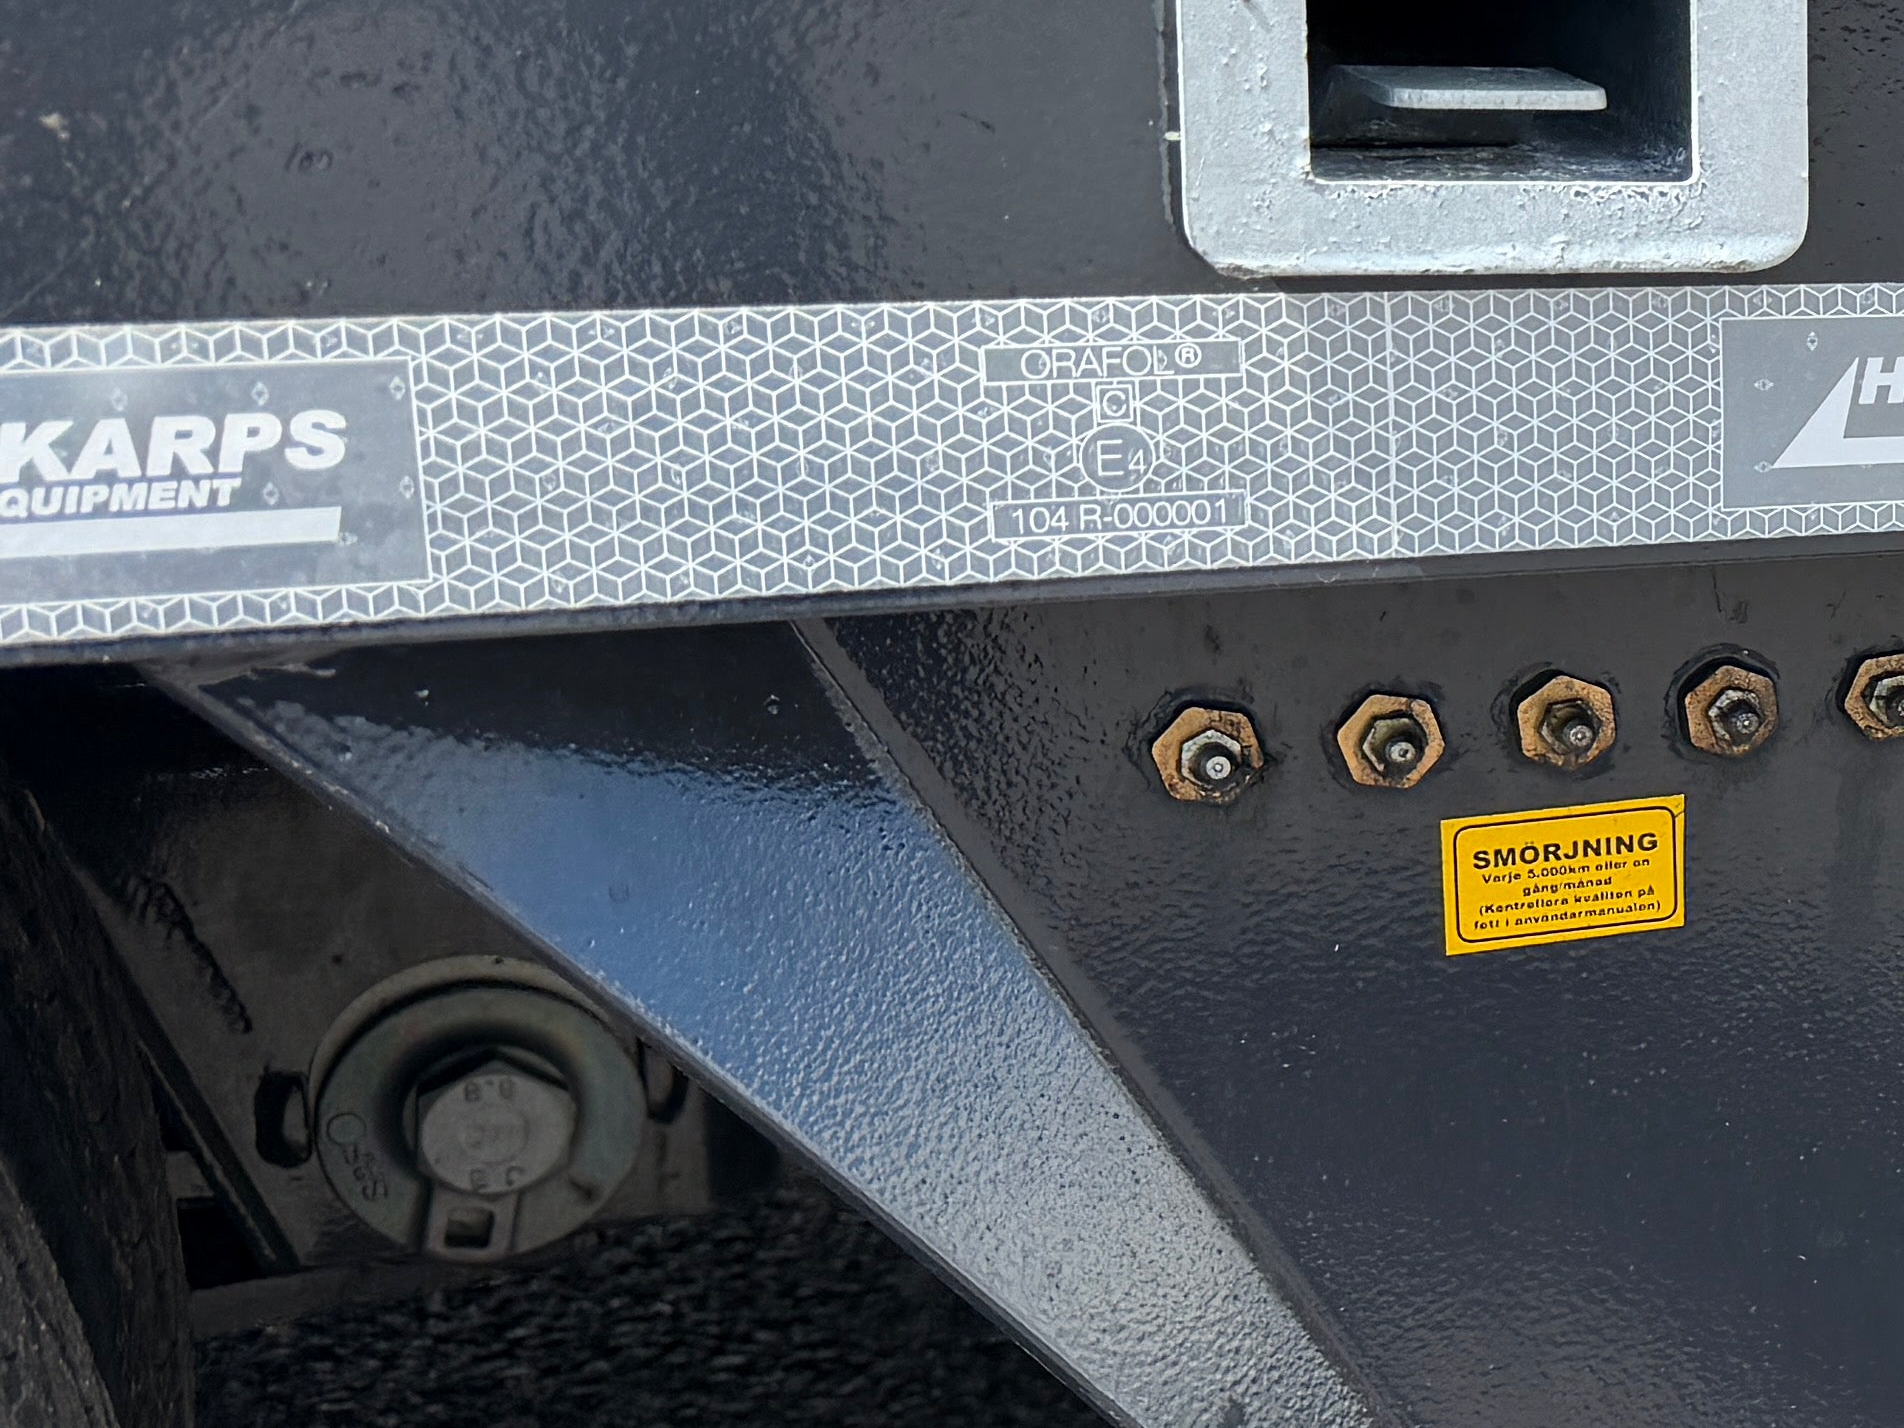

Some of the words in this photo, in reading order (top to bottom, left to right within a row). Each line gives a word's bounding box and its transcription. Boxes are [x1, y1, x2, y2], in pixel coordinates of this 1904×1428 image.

[1011, 505, 1070, 534] 104
[1079, 498, 1227, 531] R-000001
[1473, 832, 1658, 870] SMÖRJNING
[1481, 871, 1522, 884] Varje
[1595, 859, 1628, 871] eller
[1633, 858, 1650, 868] en
[1479, 897, 1569, 916] (Kontrollera
[1637, 883, 1655, 899] på
[1522, 876, 1612, 897] gång/månad
[1474, 918, 1500, 930] fett
